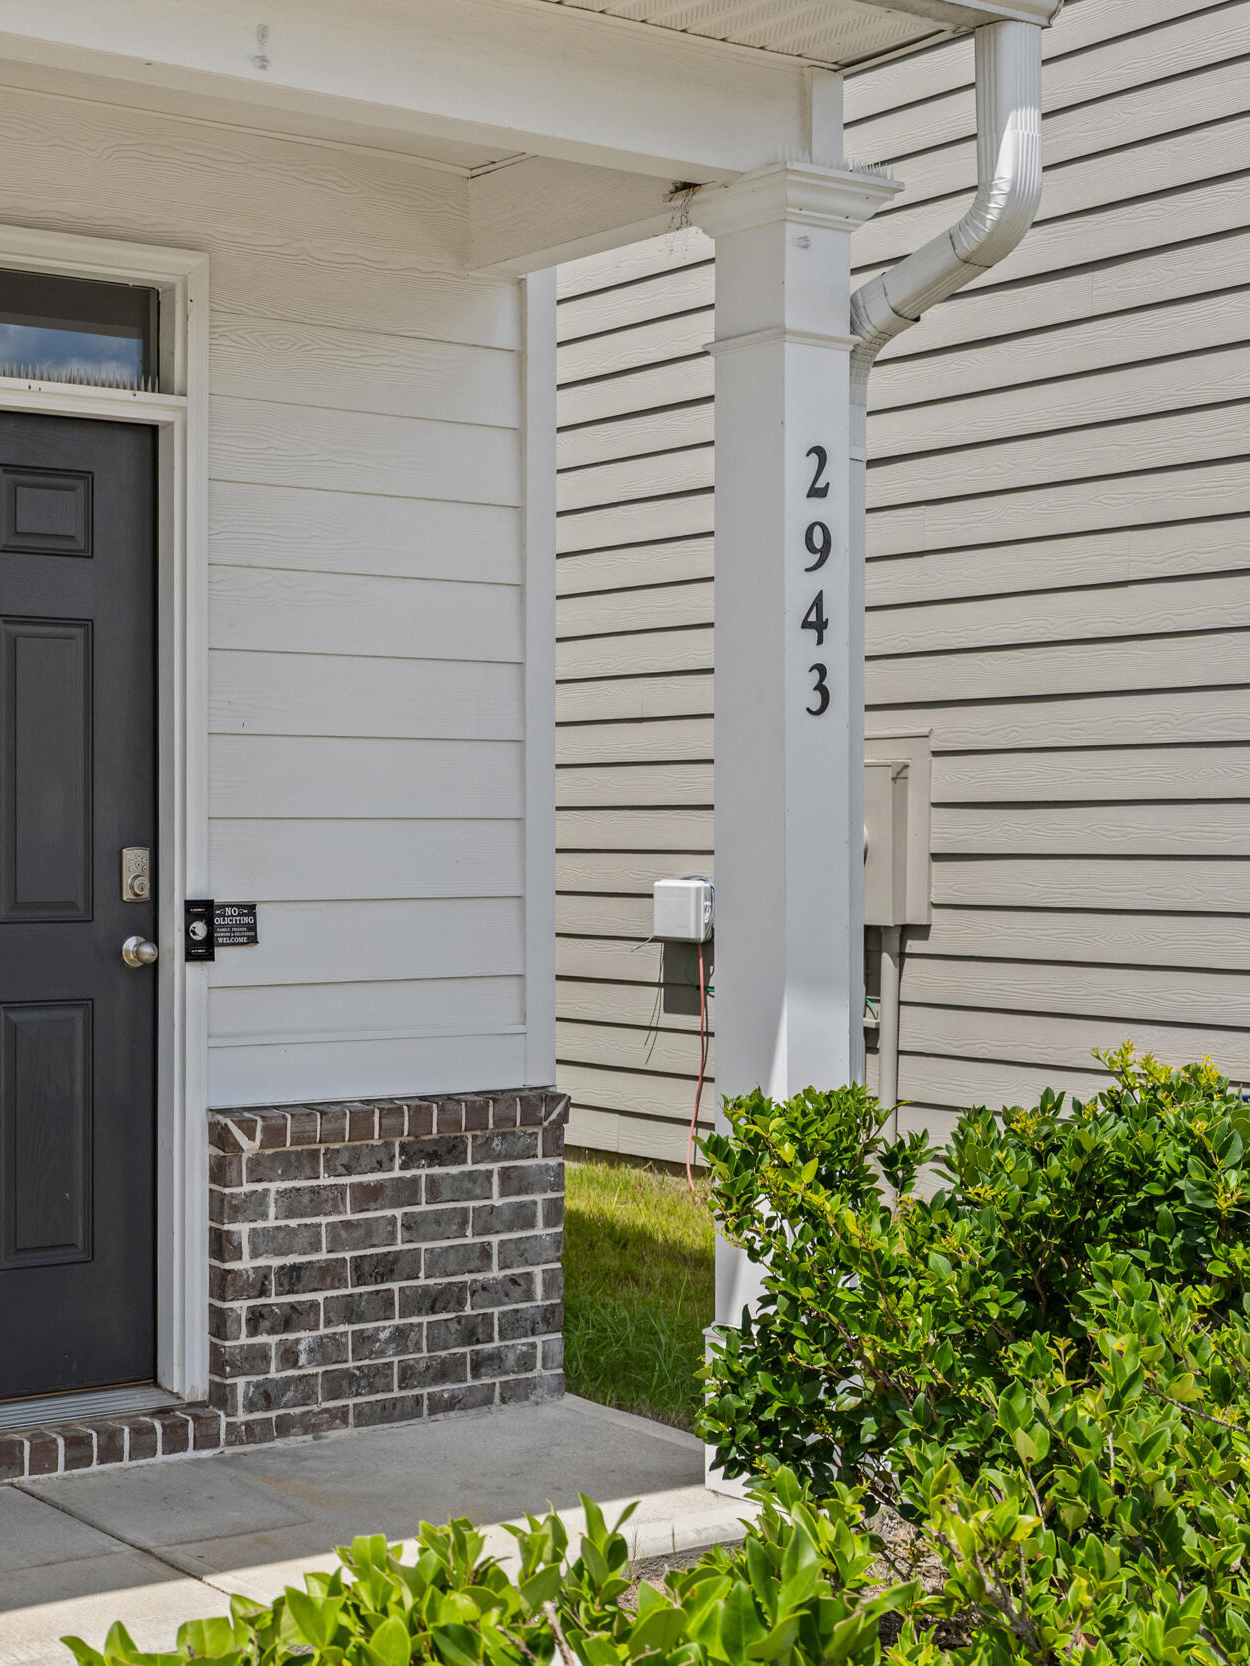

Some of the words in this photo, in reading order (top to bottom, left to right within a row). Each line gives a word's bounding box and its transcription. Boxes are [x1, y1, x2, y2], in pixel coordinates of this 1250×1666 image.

[801, 445, 832, 717] 2943
[225, 907, 238, 916] NO
[214, 916, 254, 924] OLICITING
